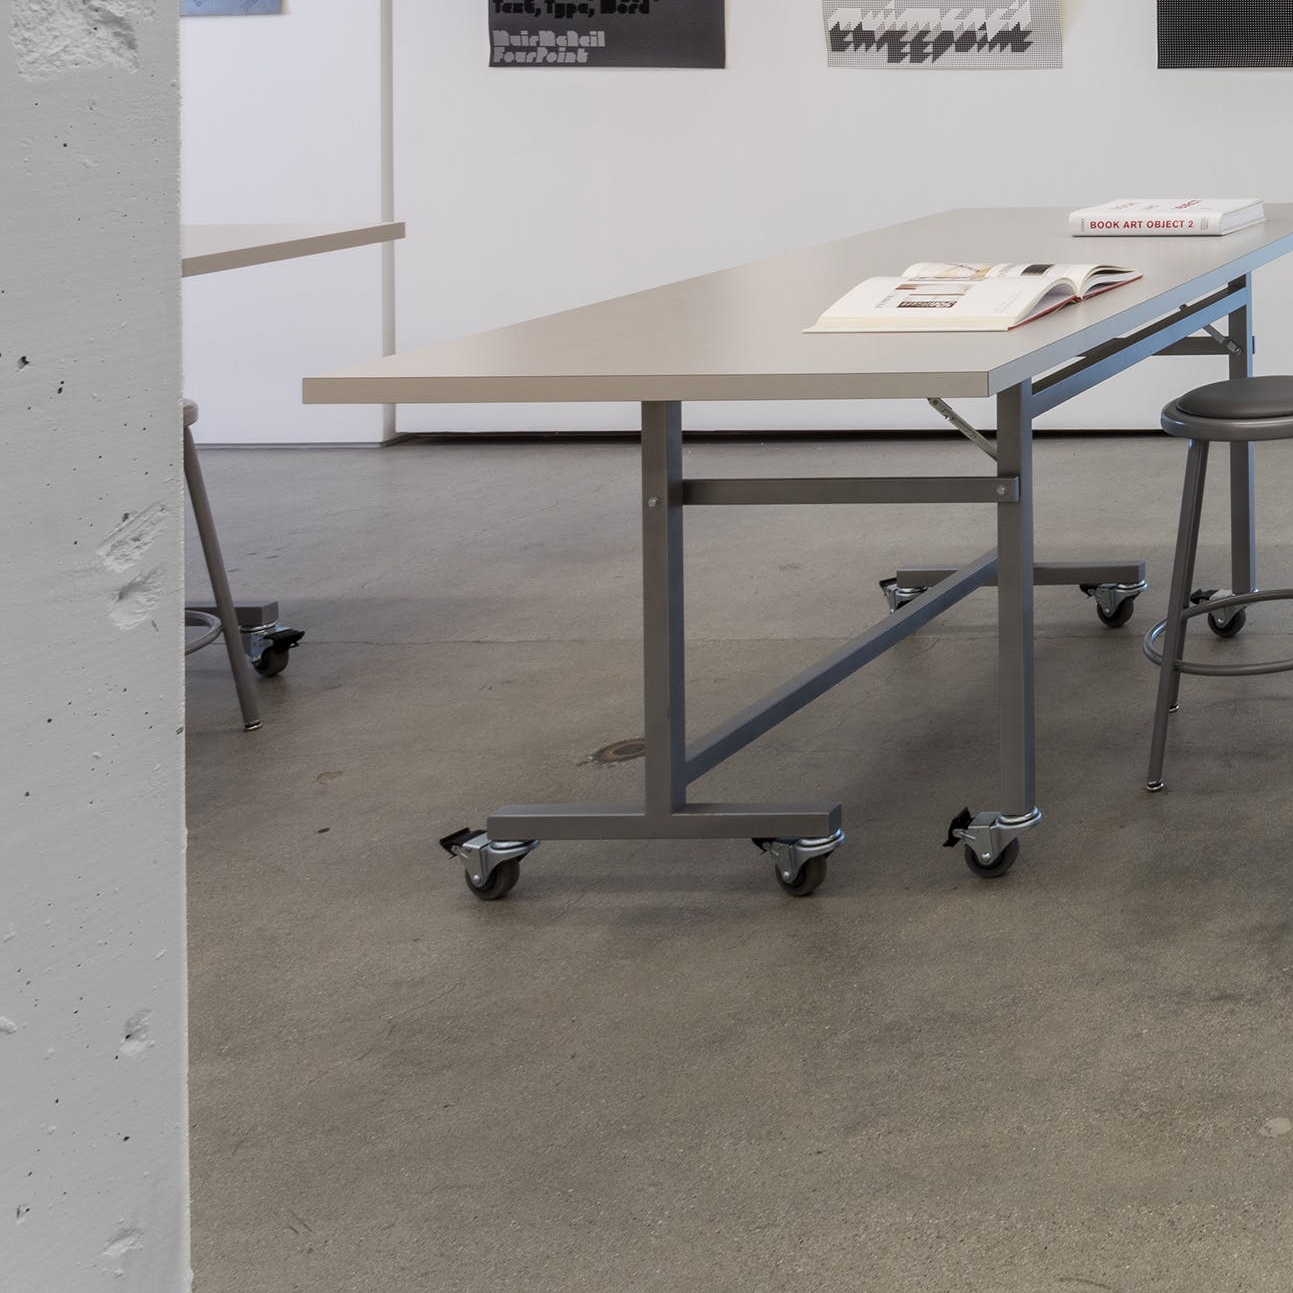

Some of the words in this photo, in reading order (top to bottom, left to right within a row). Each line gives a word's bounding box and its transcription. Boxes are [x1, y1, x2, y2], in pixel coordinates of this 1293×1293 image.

[493, 30, 605, 47] MuirMcNeil
[493, 47, 588, 63] FourPoint
[1146, 220, 1184, 228] OBJECT
